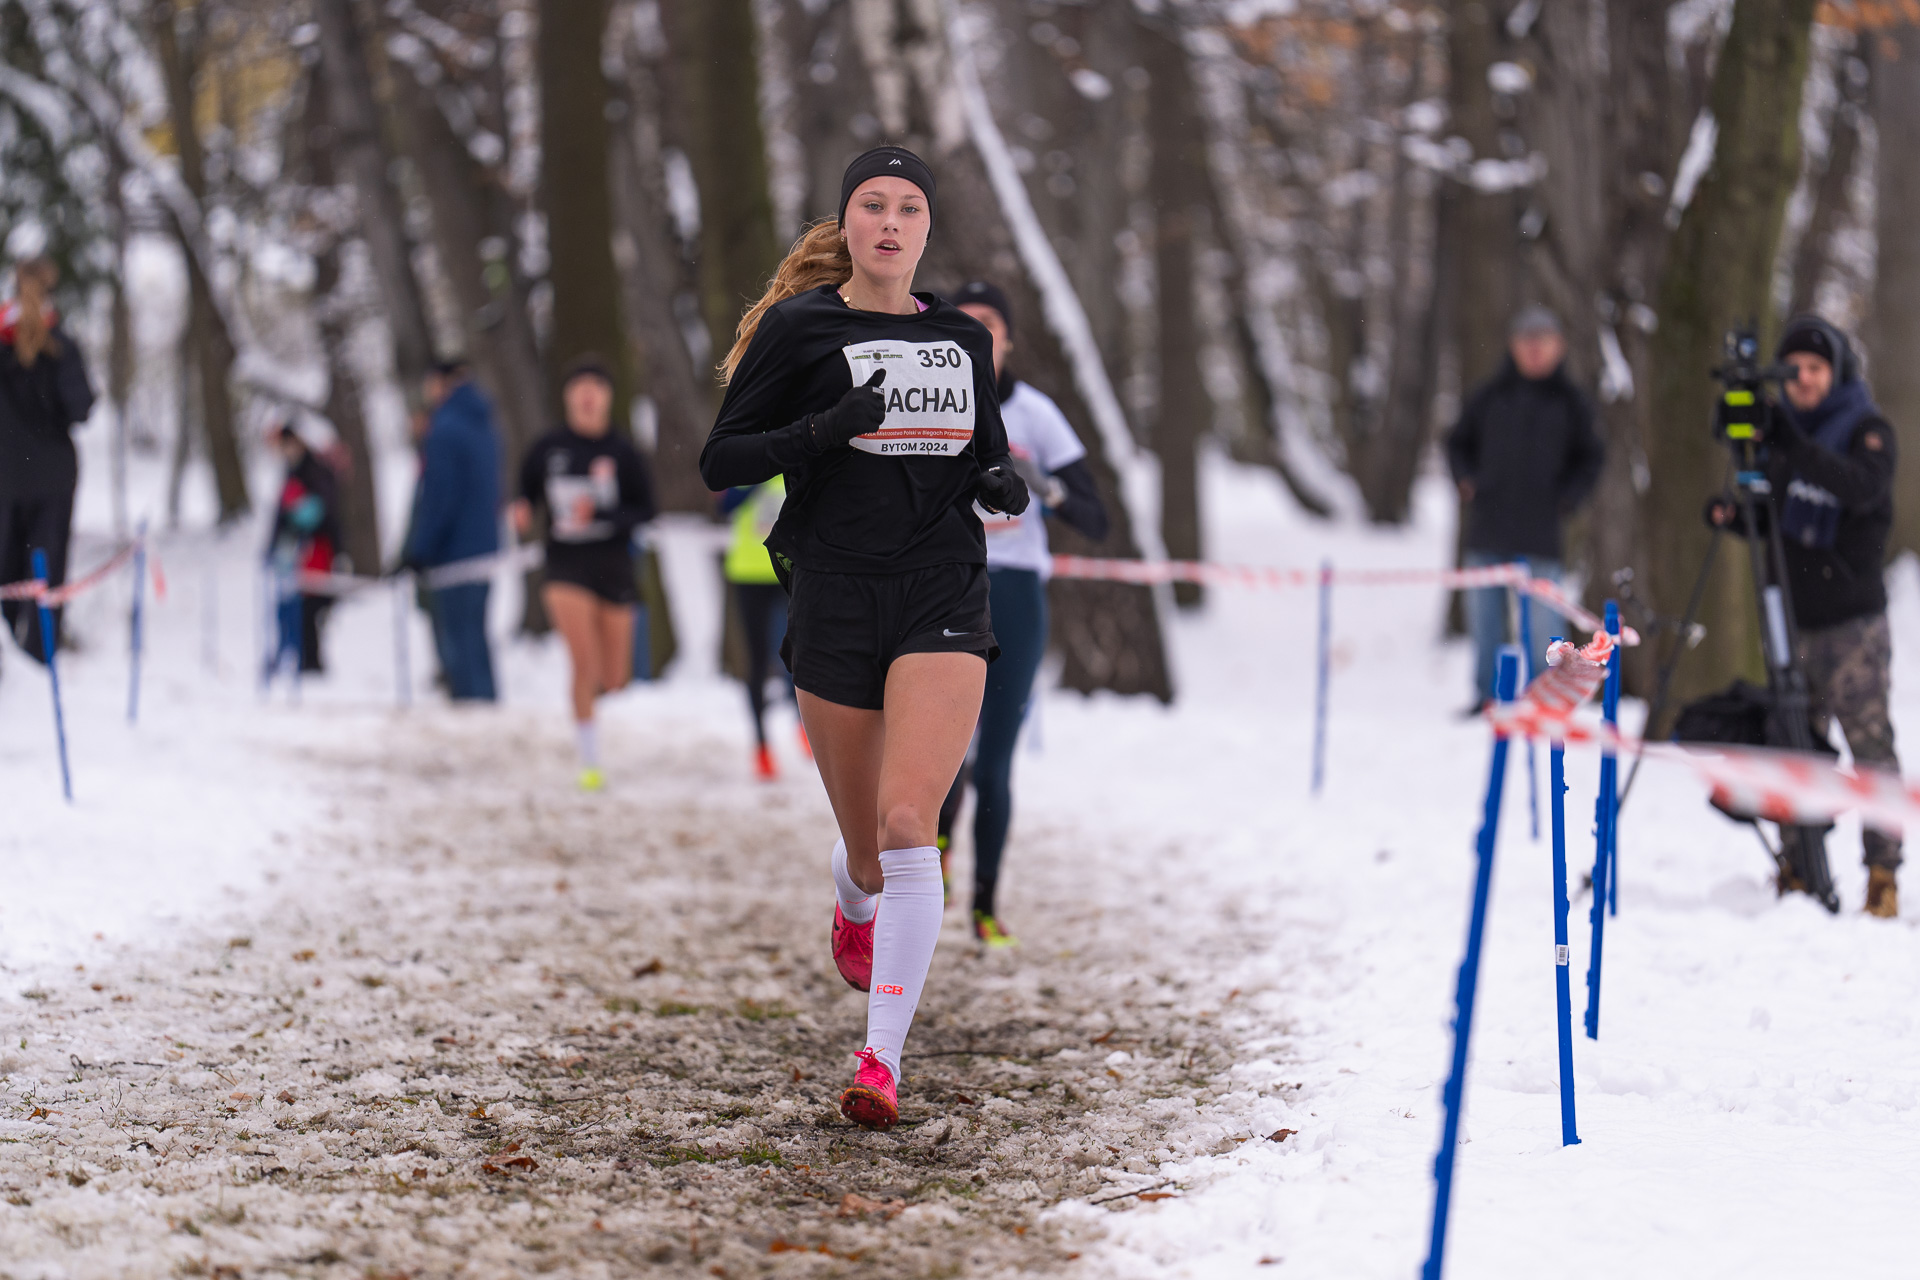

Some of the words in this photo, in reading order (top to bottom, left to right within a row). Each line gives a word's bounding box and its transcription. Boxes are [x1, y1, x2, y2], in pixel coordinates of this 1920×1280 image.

[917, 348, 961, 368] 350
[883, 387, 968, 413] ACHAJ
[881, 442, 917, 452] BYTOM
[920, 442, 948, 452] 2024
[876, 984, 903, 996] FCB
